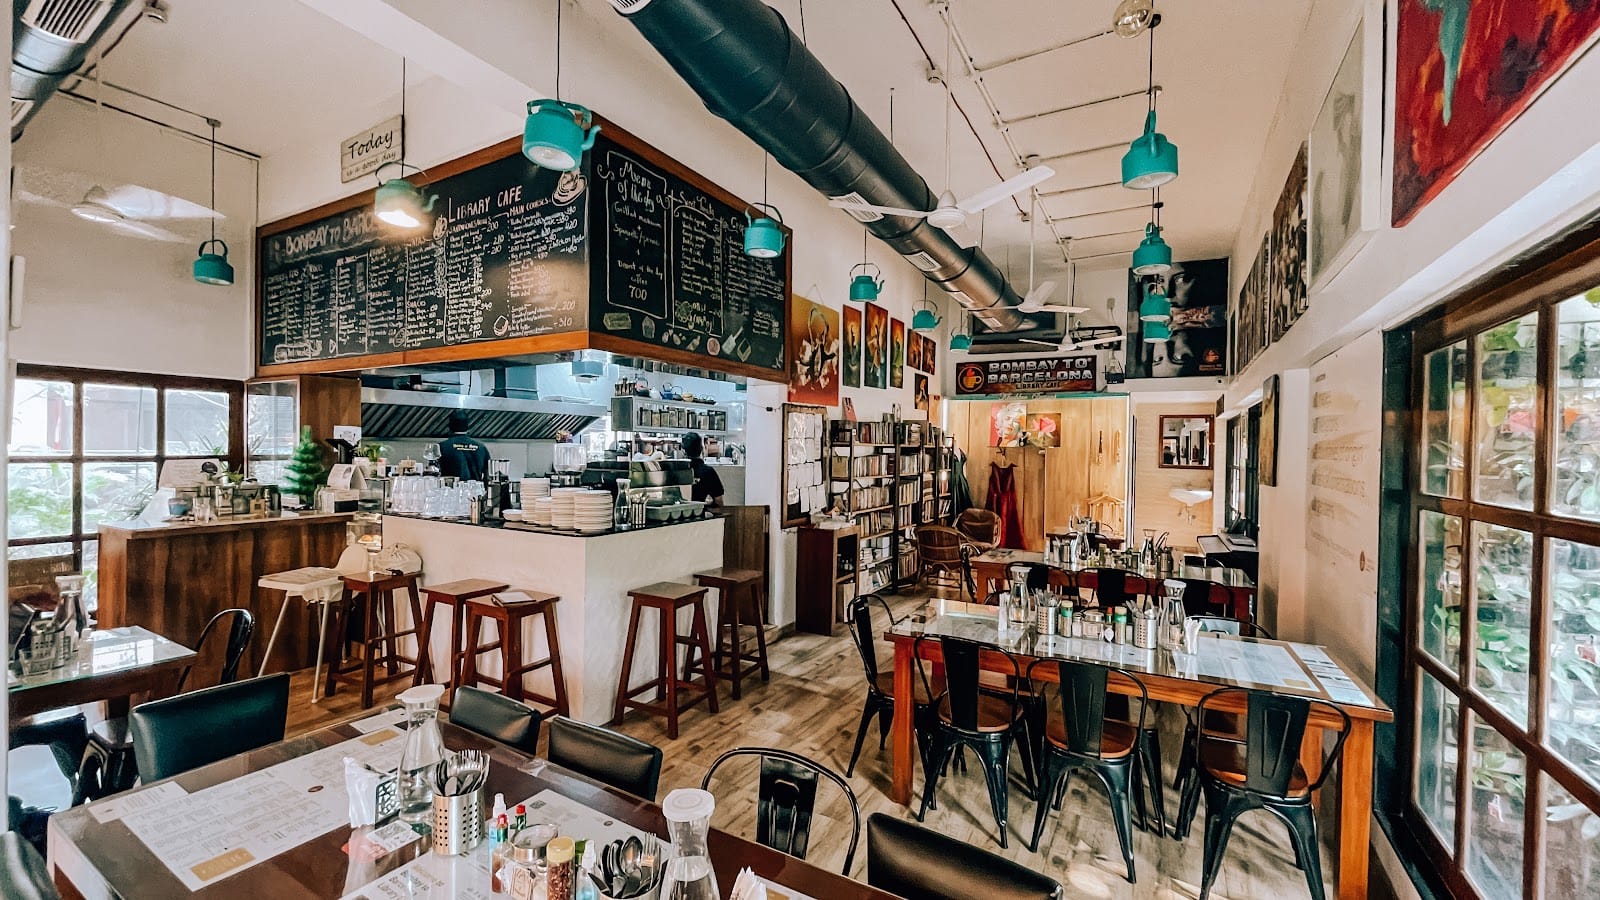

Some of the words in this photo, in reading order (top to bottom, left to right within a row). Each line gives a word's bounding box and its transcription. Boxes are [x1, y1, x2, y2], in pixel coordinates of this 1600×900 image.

[348, 130, 393, 159] Today
[448, 196, 491, 223] LIBRARY
[497, 185, 523, 208] CAFE
[509, 204, 525, 217] MAIN
[286, 224, 329, 254] BOMBAY
[329, 227, 341, 242] TO
[628, 285, 648, 300] 700
[988, 359, 1058, 373] BOMBAY
[1062, 358, 1088, 369] TO
[987, 369, 1093, 384] BARCELONA
